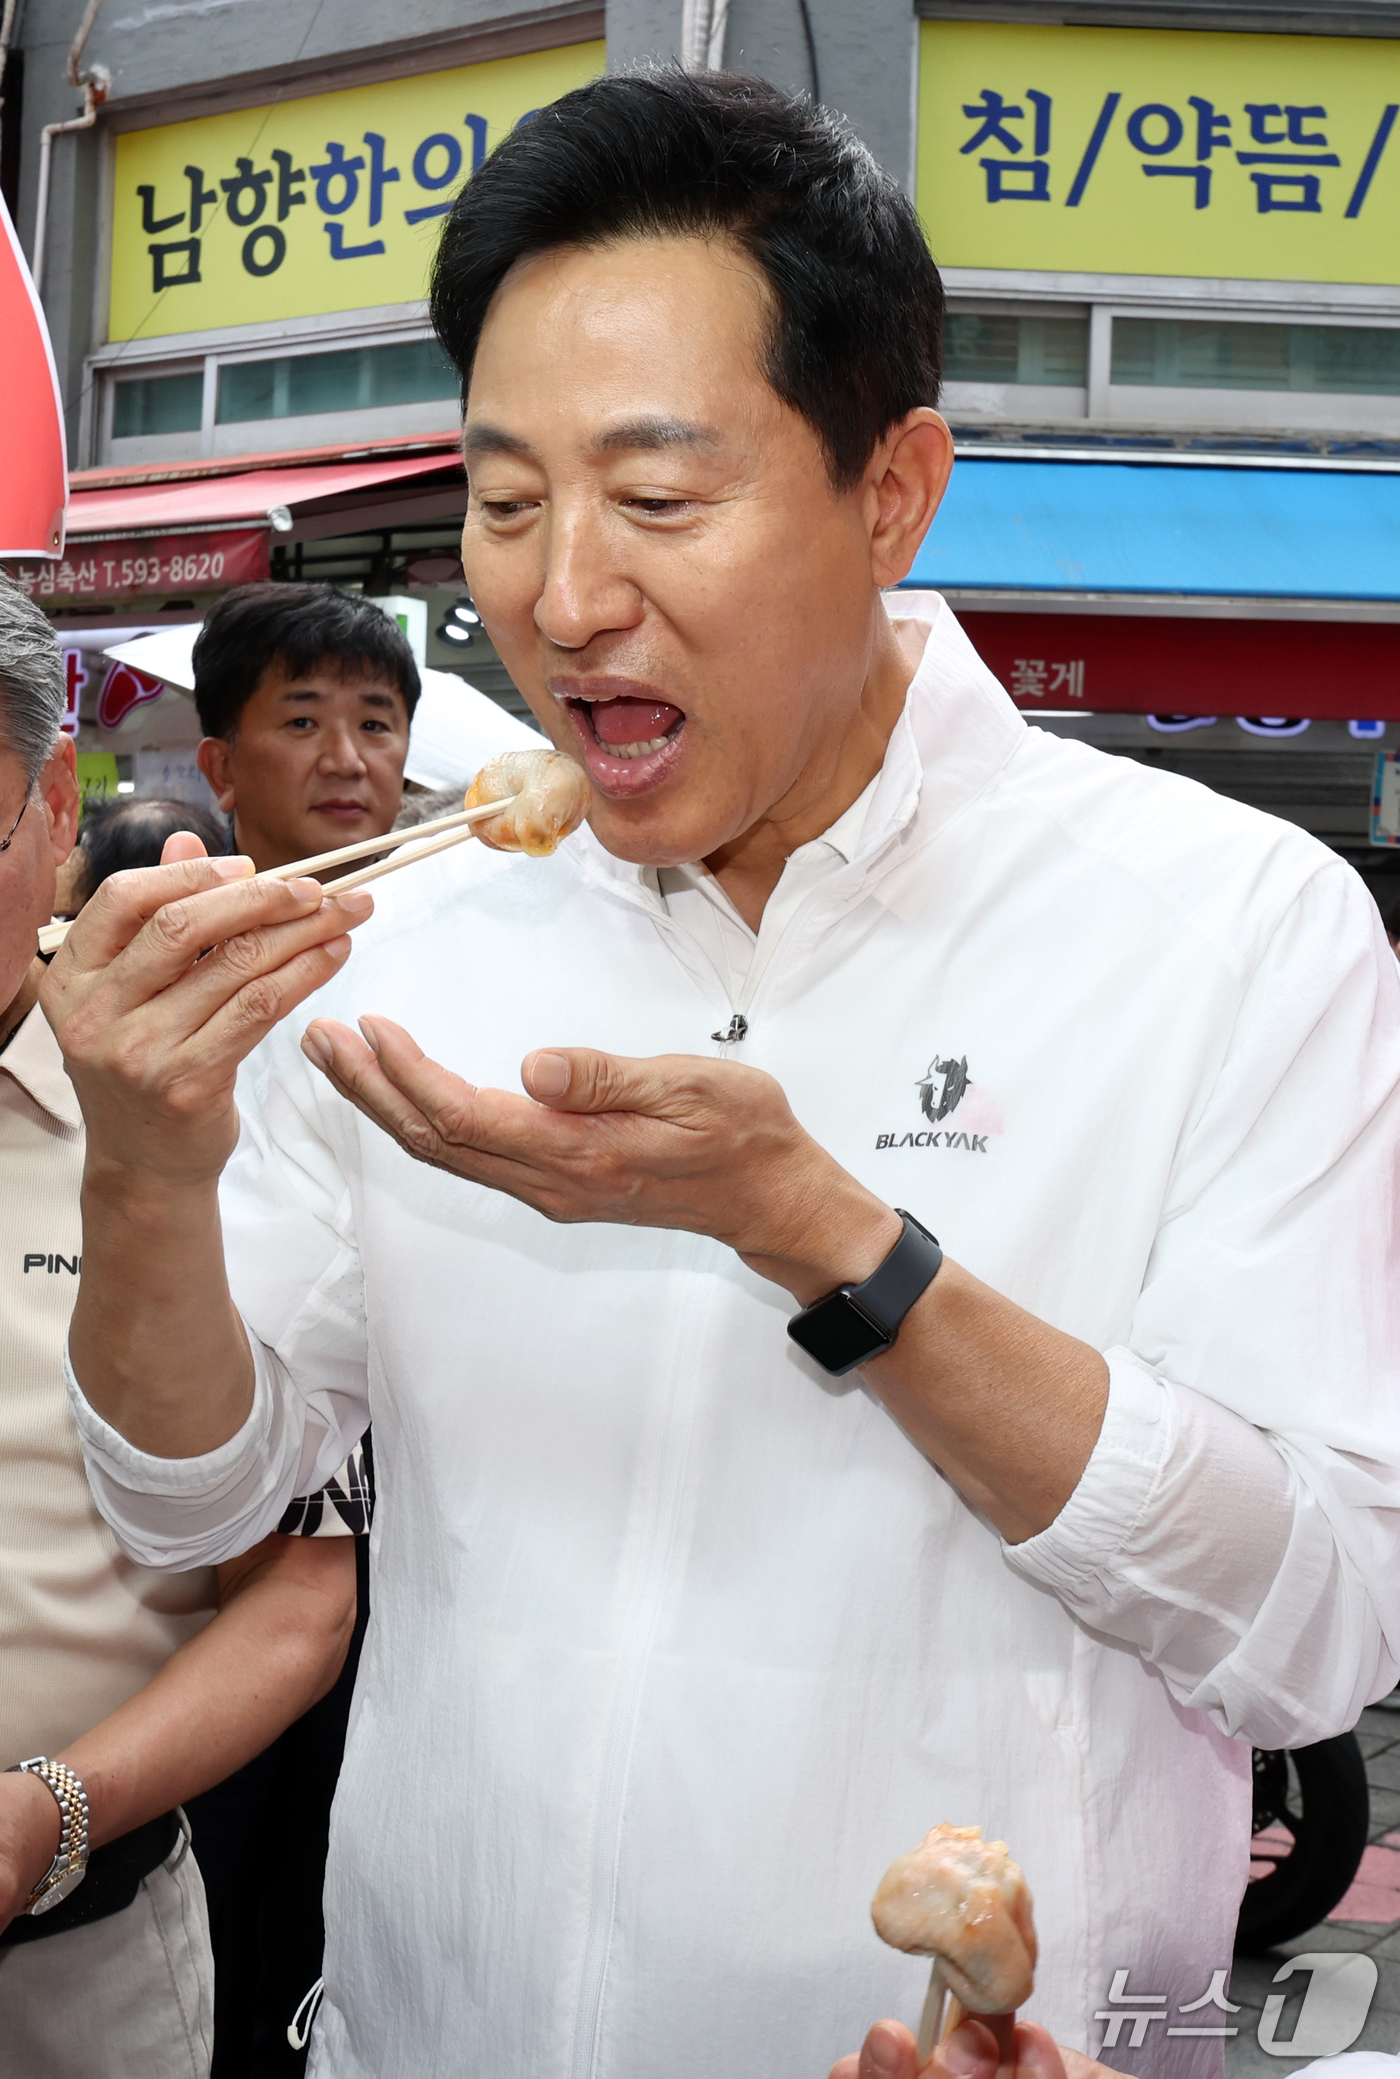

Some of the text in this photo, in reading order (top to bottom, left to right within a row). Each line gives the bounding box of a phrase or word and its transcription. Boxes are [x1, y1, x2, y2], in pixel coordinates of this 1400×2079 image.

[137, 109, 541, 292] 남향한의
[103, 552, 224, 588] T.593-8620
[1010, 659, 1084, 698] 꽃게
